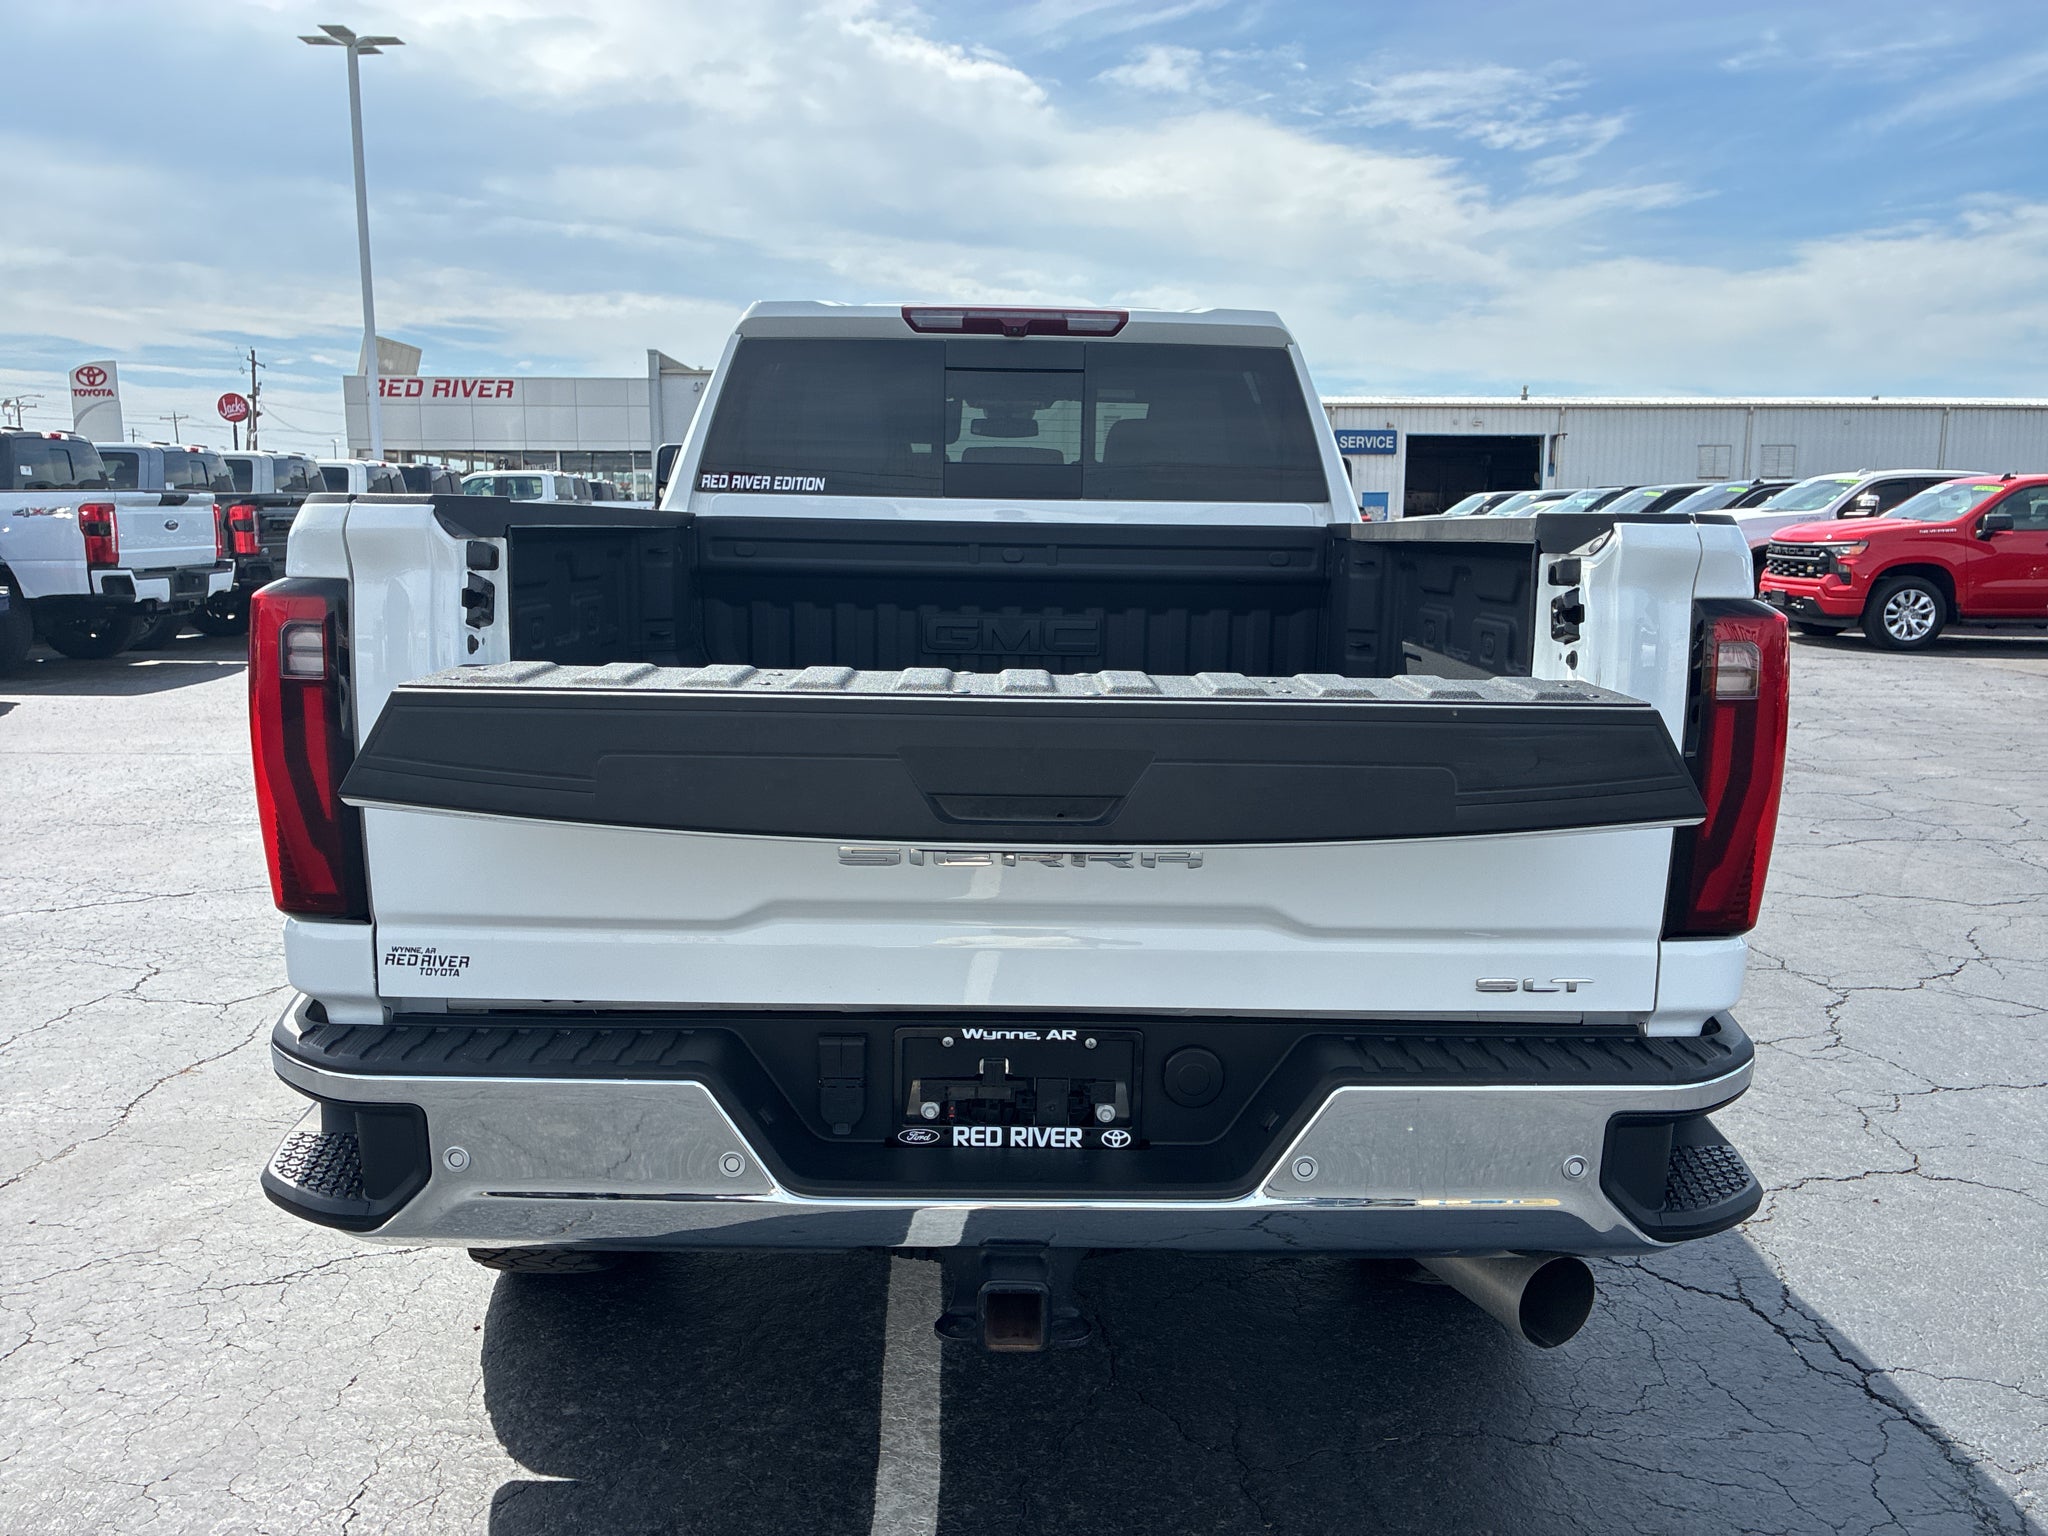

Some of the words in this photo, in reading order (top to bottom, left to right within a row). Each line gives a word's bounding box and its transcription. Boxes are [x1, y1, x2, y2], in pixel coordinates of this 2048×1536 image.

[72, 388, 114, 397] TOYOTA
[432, 378, 515, 398] RIVER
[1338, 435, 1394, 449] SERVICE
[701, 474, 729, 489] RED
[731, 475, 771, 490] RIVER
[773, 476, 826, 491] EDITION
[926, 619, 1098, 653] GMC
[838, 846, 1204, 869] SIERRA
[391, 945, 423, 954] WYNNE,
[384, 953, 419, 966] RED
[420, 954, 470, 968] RIVER
[419, 967, 460, 977] TOYOTA
[1475, 977, 1595, 993] SLT
[961, 1028, 1041, 1041] Wynne,
[1045, 1029, 1078, 1041] AR
[904, 1130, 933, 1143] Ford
[952, 1126, 1003, 1147] RED
[1009, 1127, 1083, 1148] RIVER
